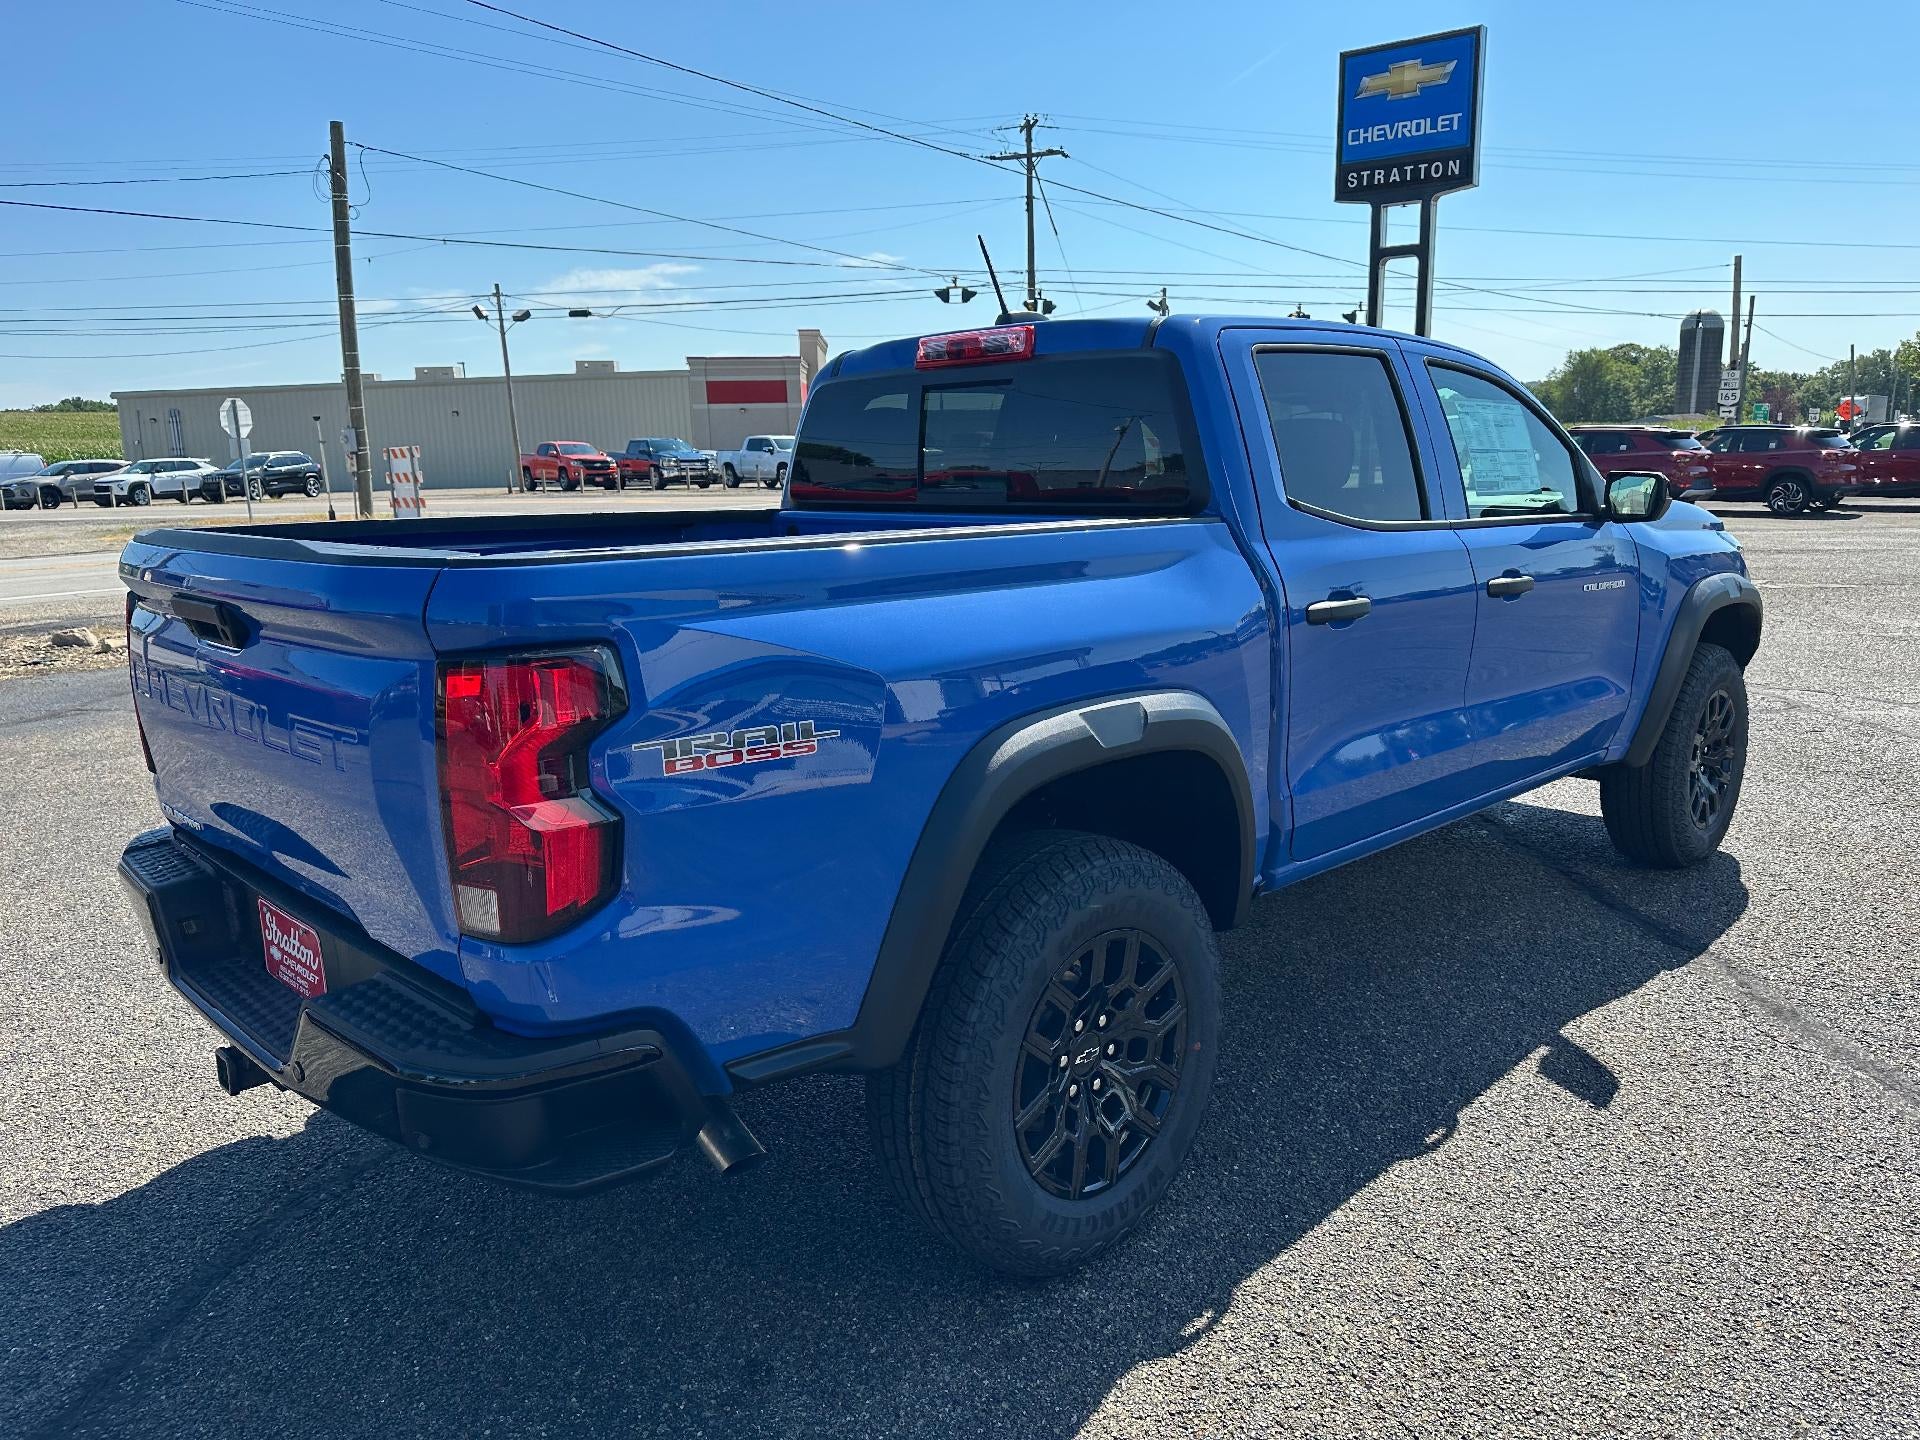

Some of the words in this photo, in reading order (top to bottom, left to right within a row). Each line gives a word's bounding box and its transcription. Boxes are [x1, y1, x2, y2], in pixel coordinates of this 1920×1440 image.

[1347, 112, 1463, 146] CHEVROLET
[1347, 159, 1460, 188] STRATTON
[1720, 392, 1737, 401] 165
[1583, 579, 1625, 592] COLORADO
[132, 657, 359, 773] CHEVROLET
[632, 719, 841, 760] TRAIL
[663, 739, 818, 777] BOSS
[265, 911, 319, 971] Stratton
[283, 954, 319, 985] CHEVROLET
